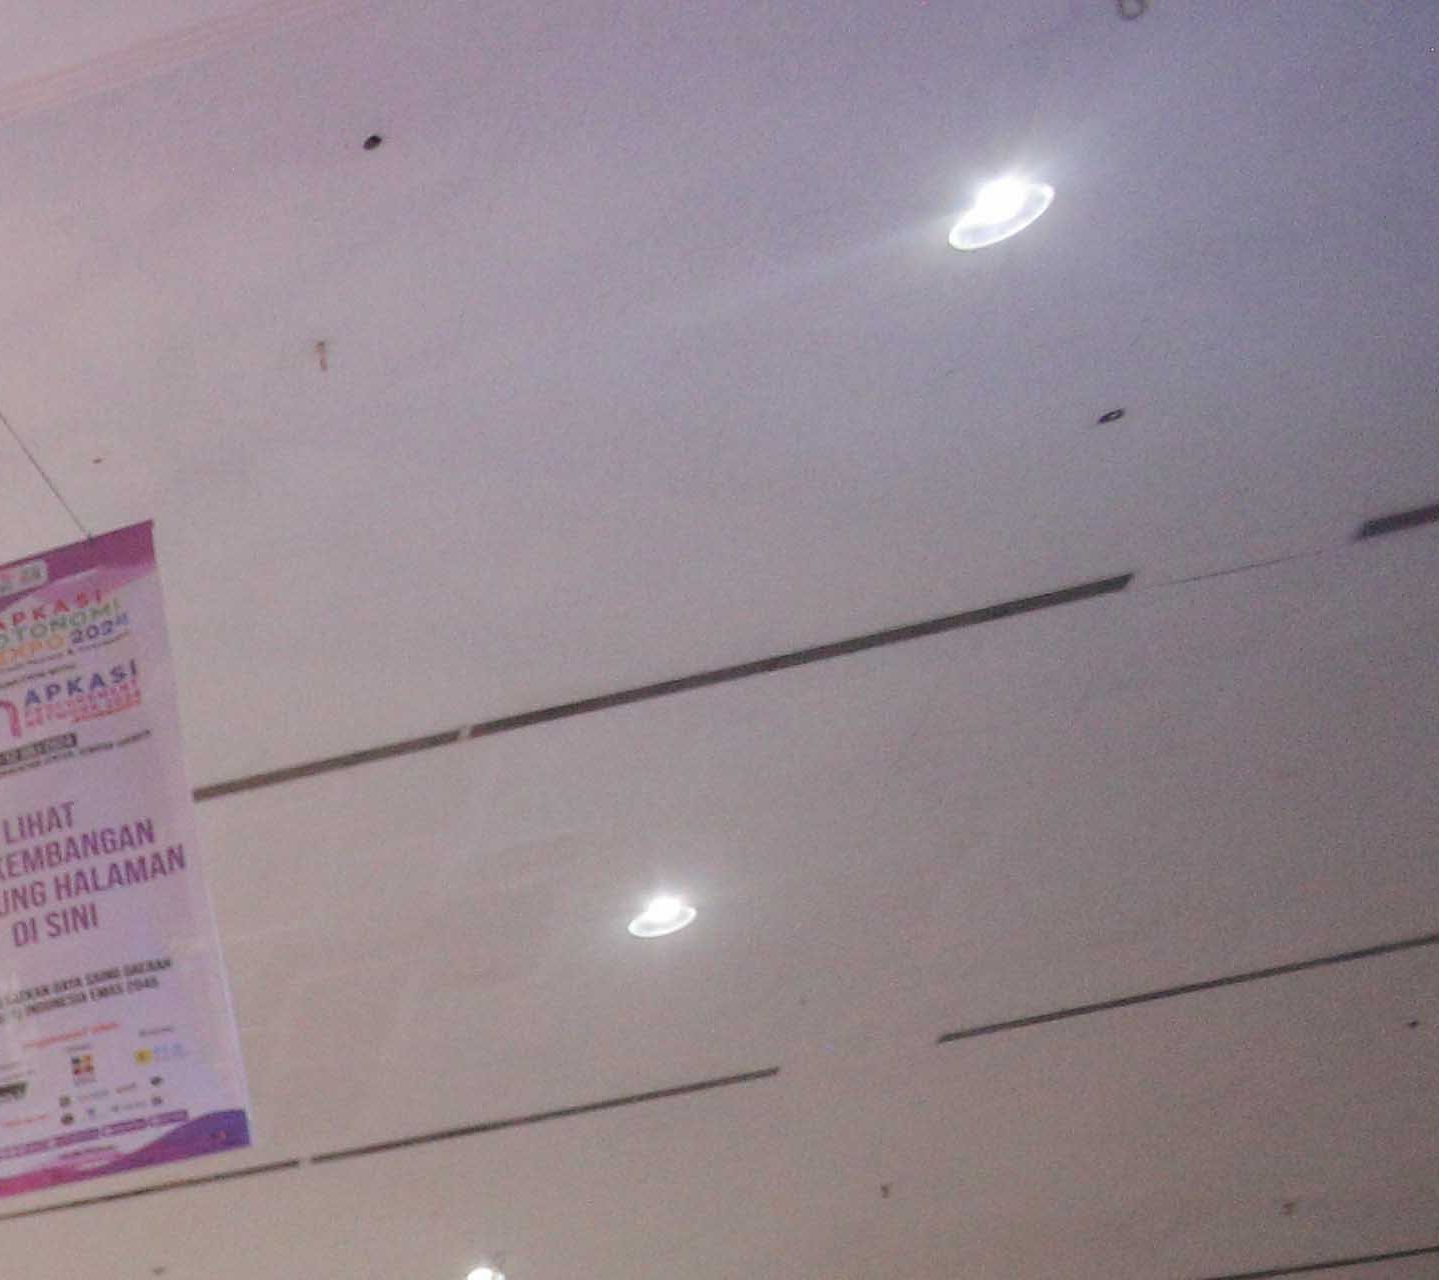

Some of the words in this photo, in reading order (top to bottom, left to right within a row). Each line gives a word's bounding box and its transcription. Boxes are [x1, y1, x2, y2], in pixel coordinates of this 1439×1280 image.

[25, 659, 138, 707] APKASI
[2, 802, 75, 844] LIHAT
[54, 844, 186, 900] HALAMAN
[11, 921, 40, 948] DI
[44, 903, 100, 937] SINI
